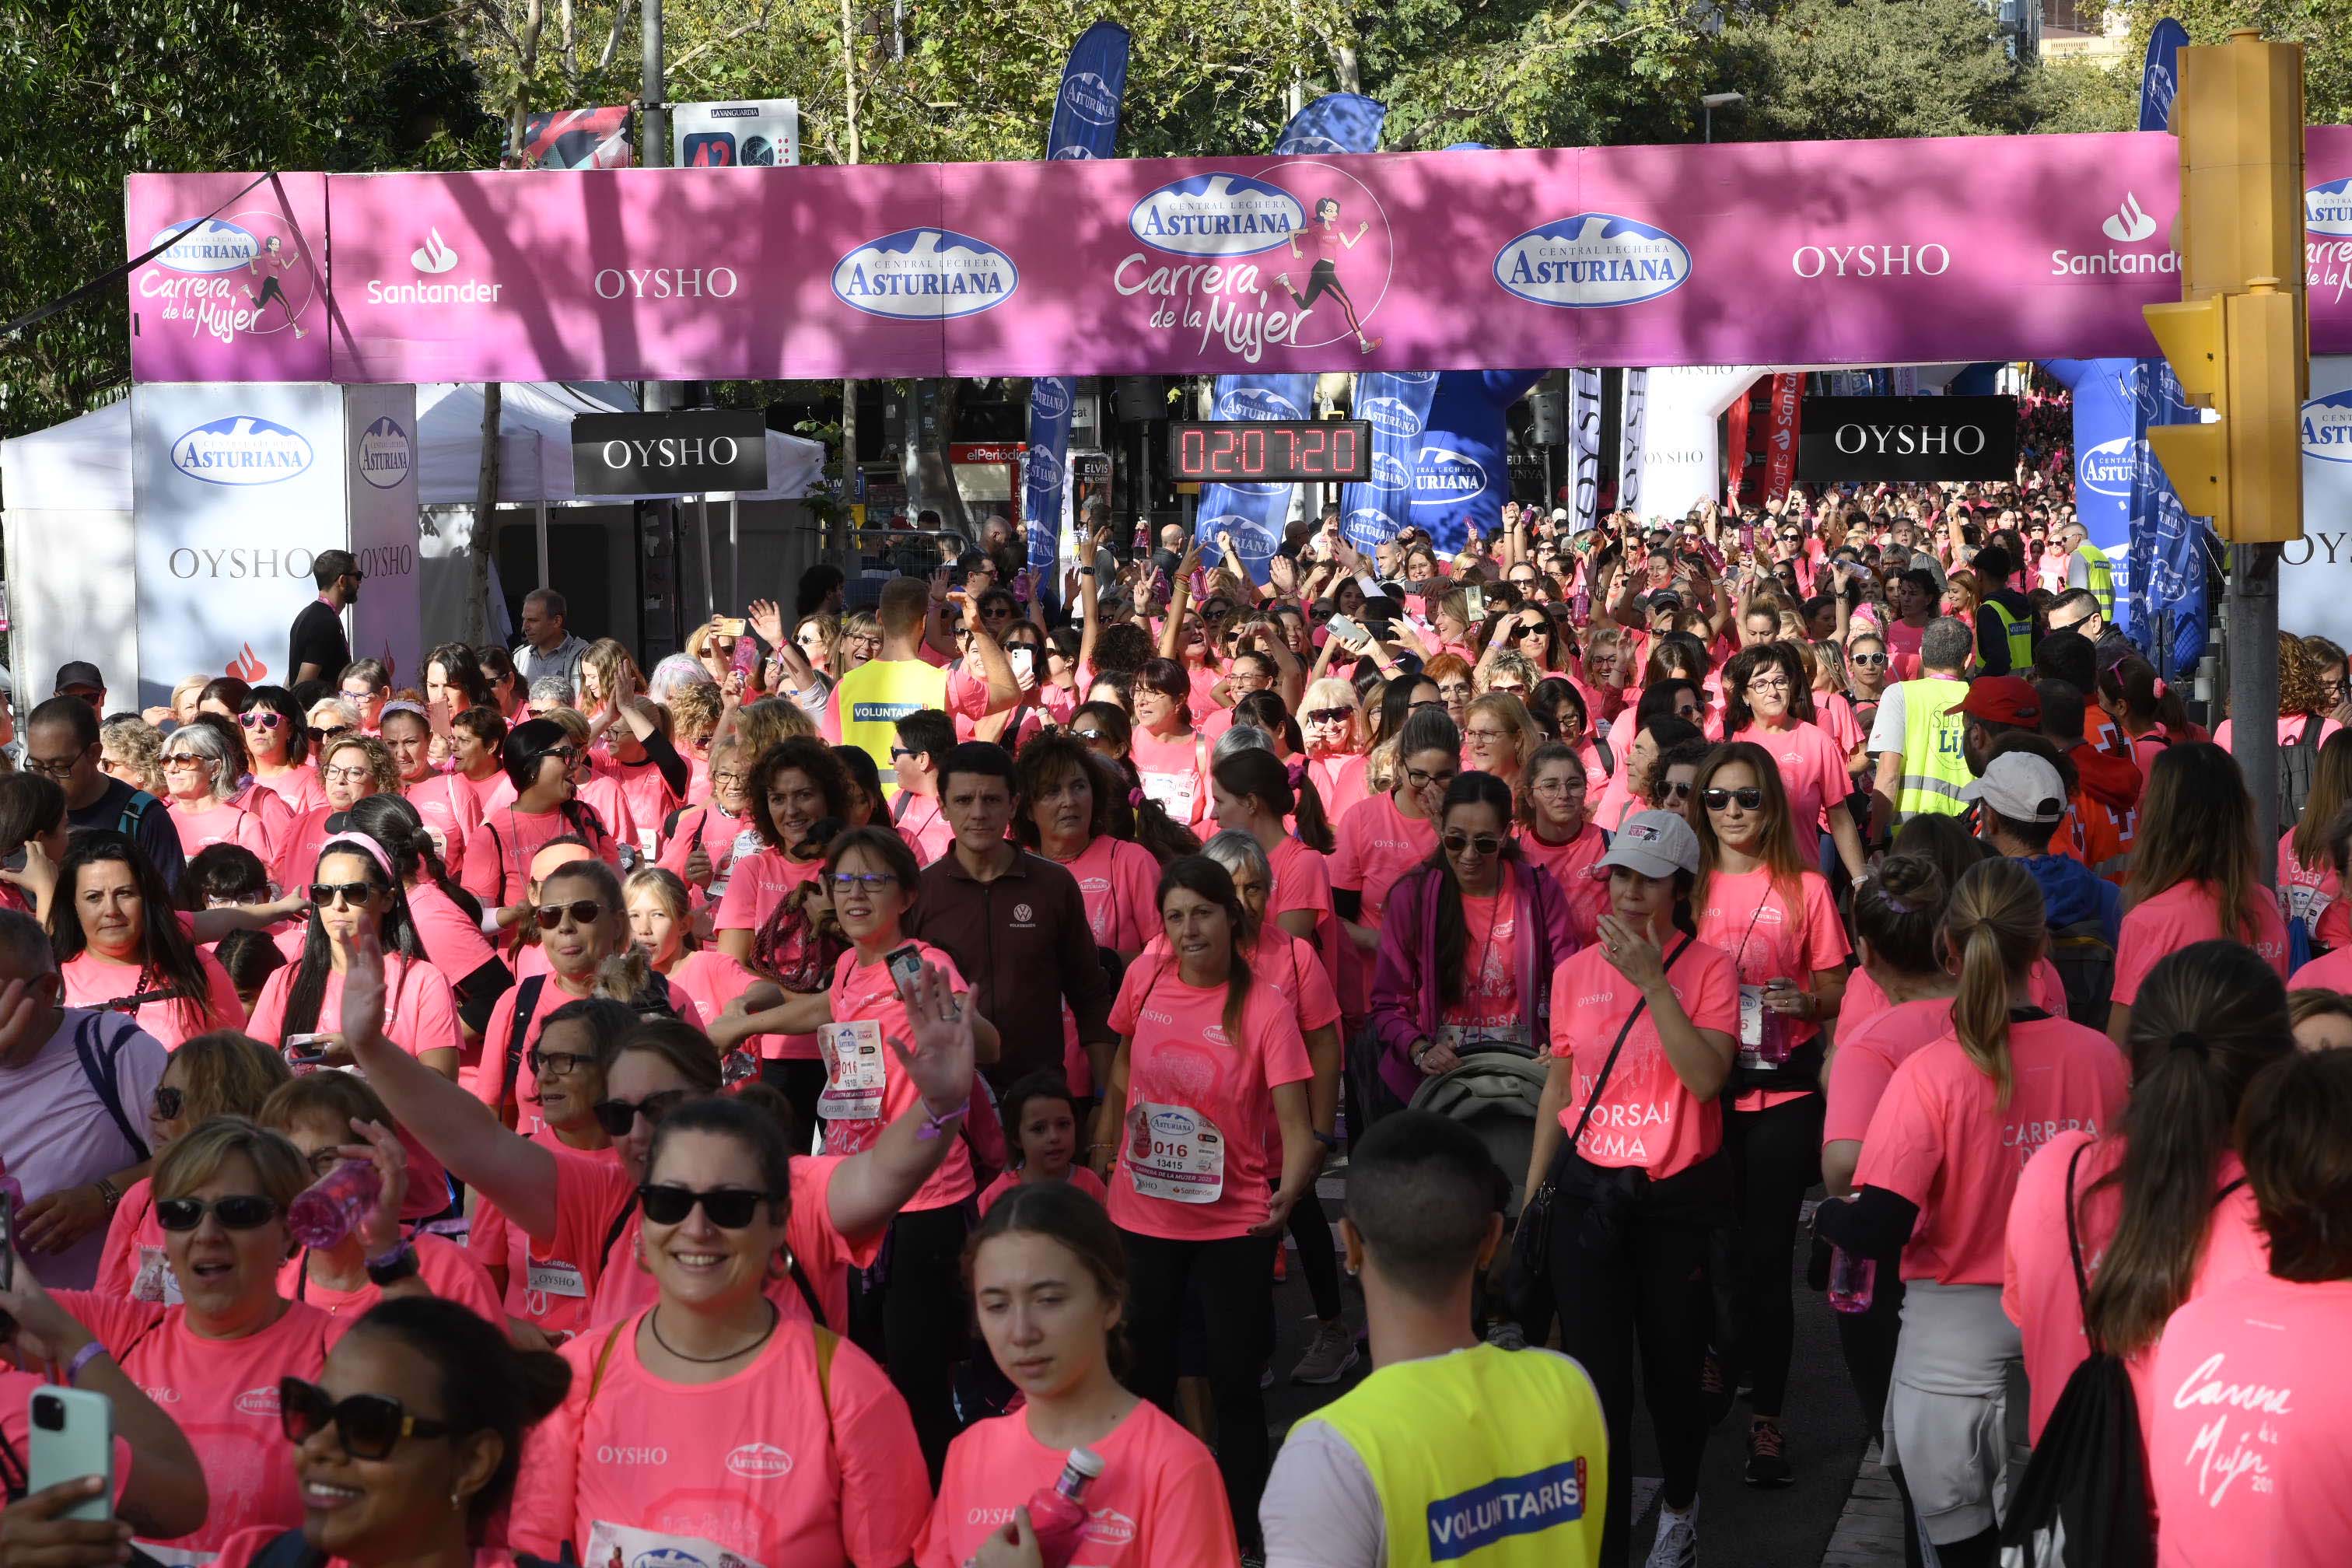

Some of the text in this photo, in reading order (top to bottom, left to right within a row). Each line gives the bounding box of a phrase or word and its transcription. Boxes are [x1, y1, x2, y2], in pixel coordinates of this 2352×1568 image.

[1067, 82, 1115, 118] ASTURIANA
[1170, 200, 1287, 212] CENTRAL LECHERA
[1143, 204, 1291, 236] ASTURIANA
[1539, 244, 1670, 257] CENTRAL LECHERA
[1792, 243, 1950, 278] OYSHO
[2052, 249, 2182, 275] Santand
[874, 259, 997, 268] CENTRAL LECHERA
[1114, 252, 1259, 296] Carrera
[1509, 250, 1676, 285] ASTURIANA
[2324, 264, 2338, 286] la
[139, 269, 231, 299] Carrera
[367, 279, 502, 304] Santander
[594, 267, 738, 299] OYSHO
[846, 262, 1003, 296] ASTURIANA
[162, 296, 265, 343] de la Mujer
[1150, 290, 1314, 364] de la Mujer
[1363, 405, 1416, 433] ASTURIANA
[1577, 368, 1600, 519] OYSH
[1623, 368, 1647, 506] OYSH
[1835, 423, 1986, 456] OYSHO
[181, 442, 303, 467] ASTURIANA
[362, 443, 408, 471] ASTURIANA
[602, 436, 738, 469] OYSHO
[1182, 430, 1356, 473] 02:07:20
[1644, 450, 1703, 465] OYSHO
[1084, 464, 1108, 474] ELVIS
[1416, 475, 1480, 490] URIANA
[169, 548, 314, 579] OYSHO
[361, 544, 412, 579] OYSHO
[855, 707, 916, 717] VOLUNTARI
[1374, 839, 1409, 849] OYSHO
[758, 880, 787, 893] YSHO
[1578, 992, 1613, 1008] OYSHO
[842, 1061, 858, 1075] 016
[1152, 1119, 1191, 1132] ASTURIANA
[1579, 1101, 1672, 1128] ORSAL
[1154, 1141, 1188, 1157] 016
[1136, 1166, 1157, 1177] CARRERA
[1174, 1174, 1196, 1182] MUJER
[1157, 1158, 1183, 1170] 13415
[1181, 1187, 1213, 1196] Santander
[539, 1275, 576, 1287] OYSHO
[597, 1445, 667, 1465] OYSHO
[732, 1455, 787, 1470] ASTURIANA
[968, 1507, 1017, 1525] OYSH
[1431, 1478, 1581, 1545] VOLUNTARIS
